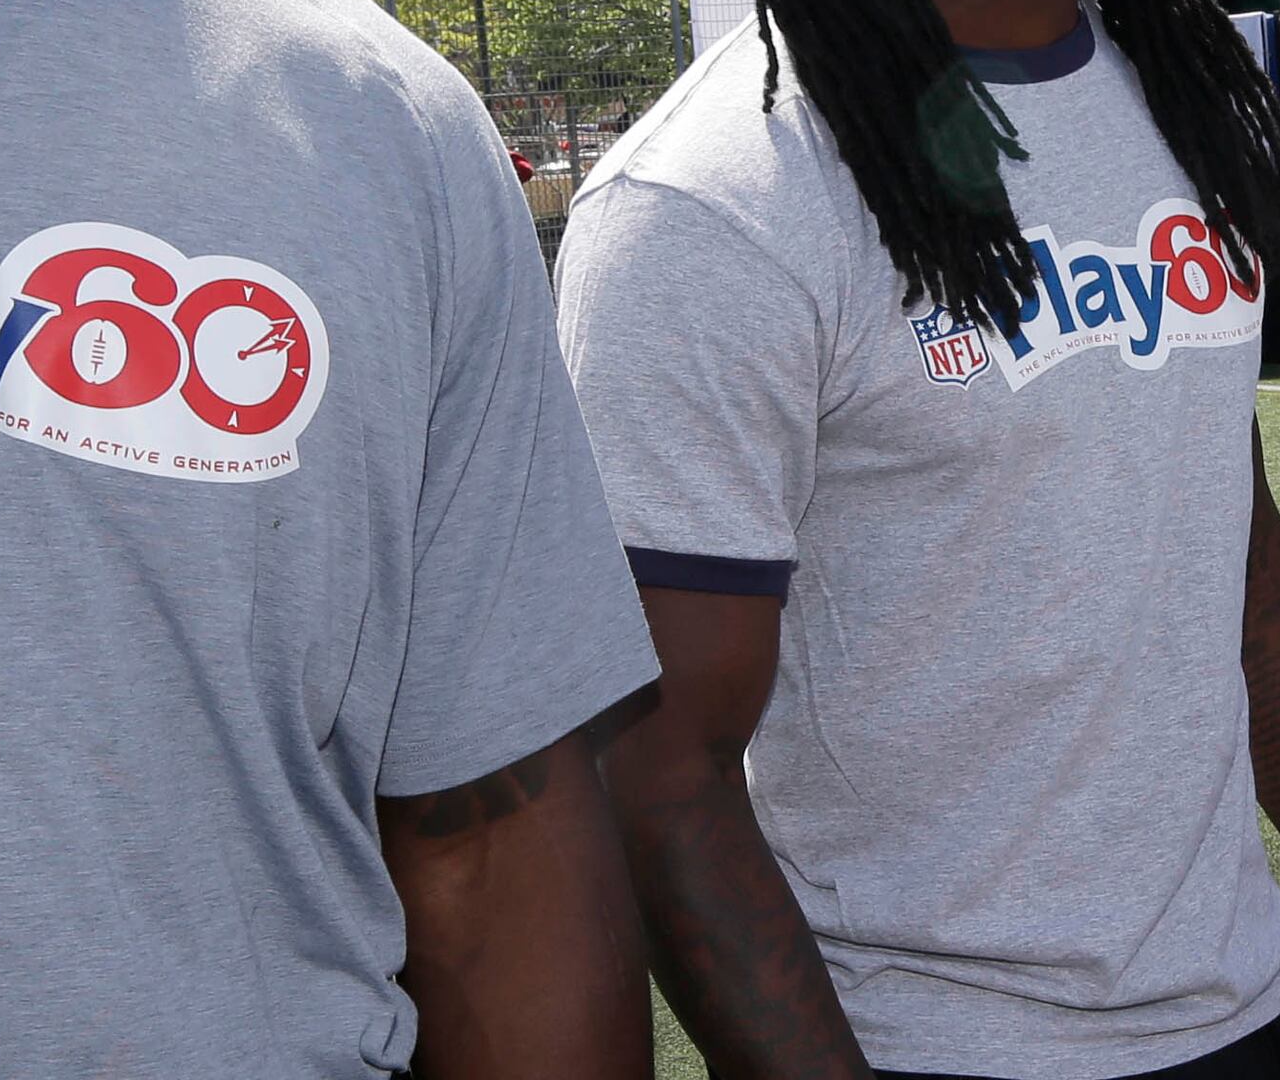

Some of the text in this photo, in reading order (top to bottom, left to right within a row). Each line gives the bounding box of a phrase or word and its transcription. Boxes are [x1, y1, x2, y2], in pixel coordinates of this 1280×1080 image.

[1167, 333, 1192, 343] FOR
[1211, 328, 1243, 340] ACTIVE
[928, 335, 984, 376] NFL
[1019, 361, 1040, 378] THE
[1043, 347, 1063, 361] NFL
[42, 425, 69, 442] AN
[80, 437, 160, 464] ACTIVE
[173, 451, 293, 474] GENERATION
